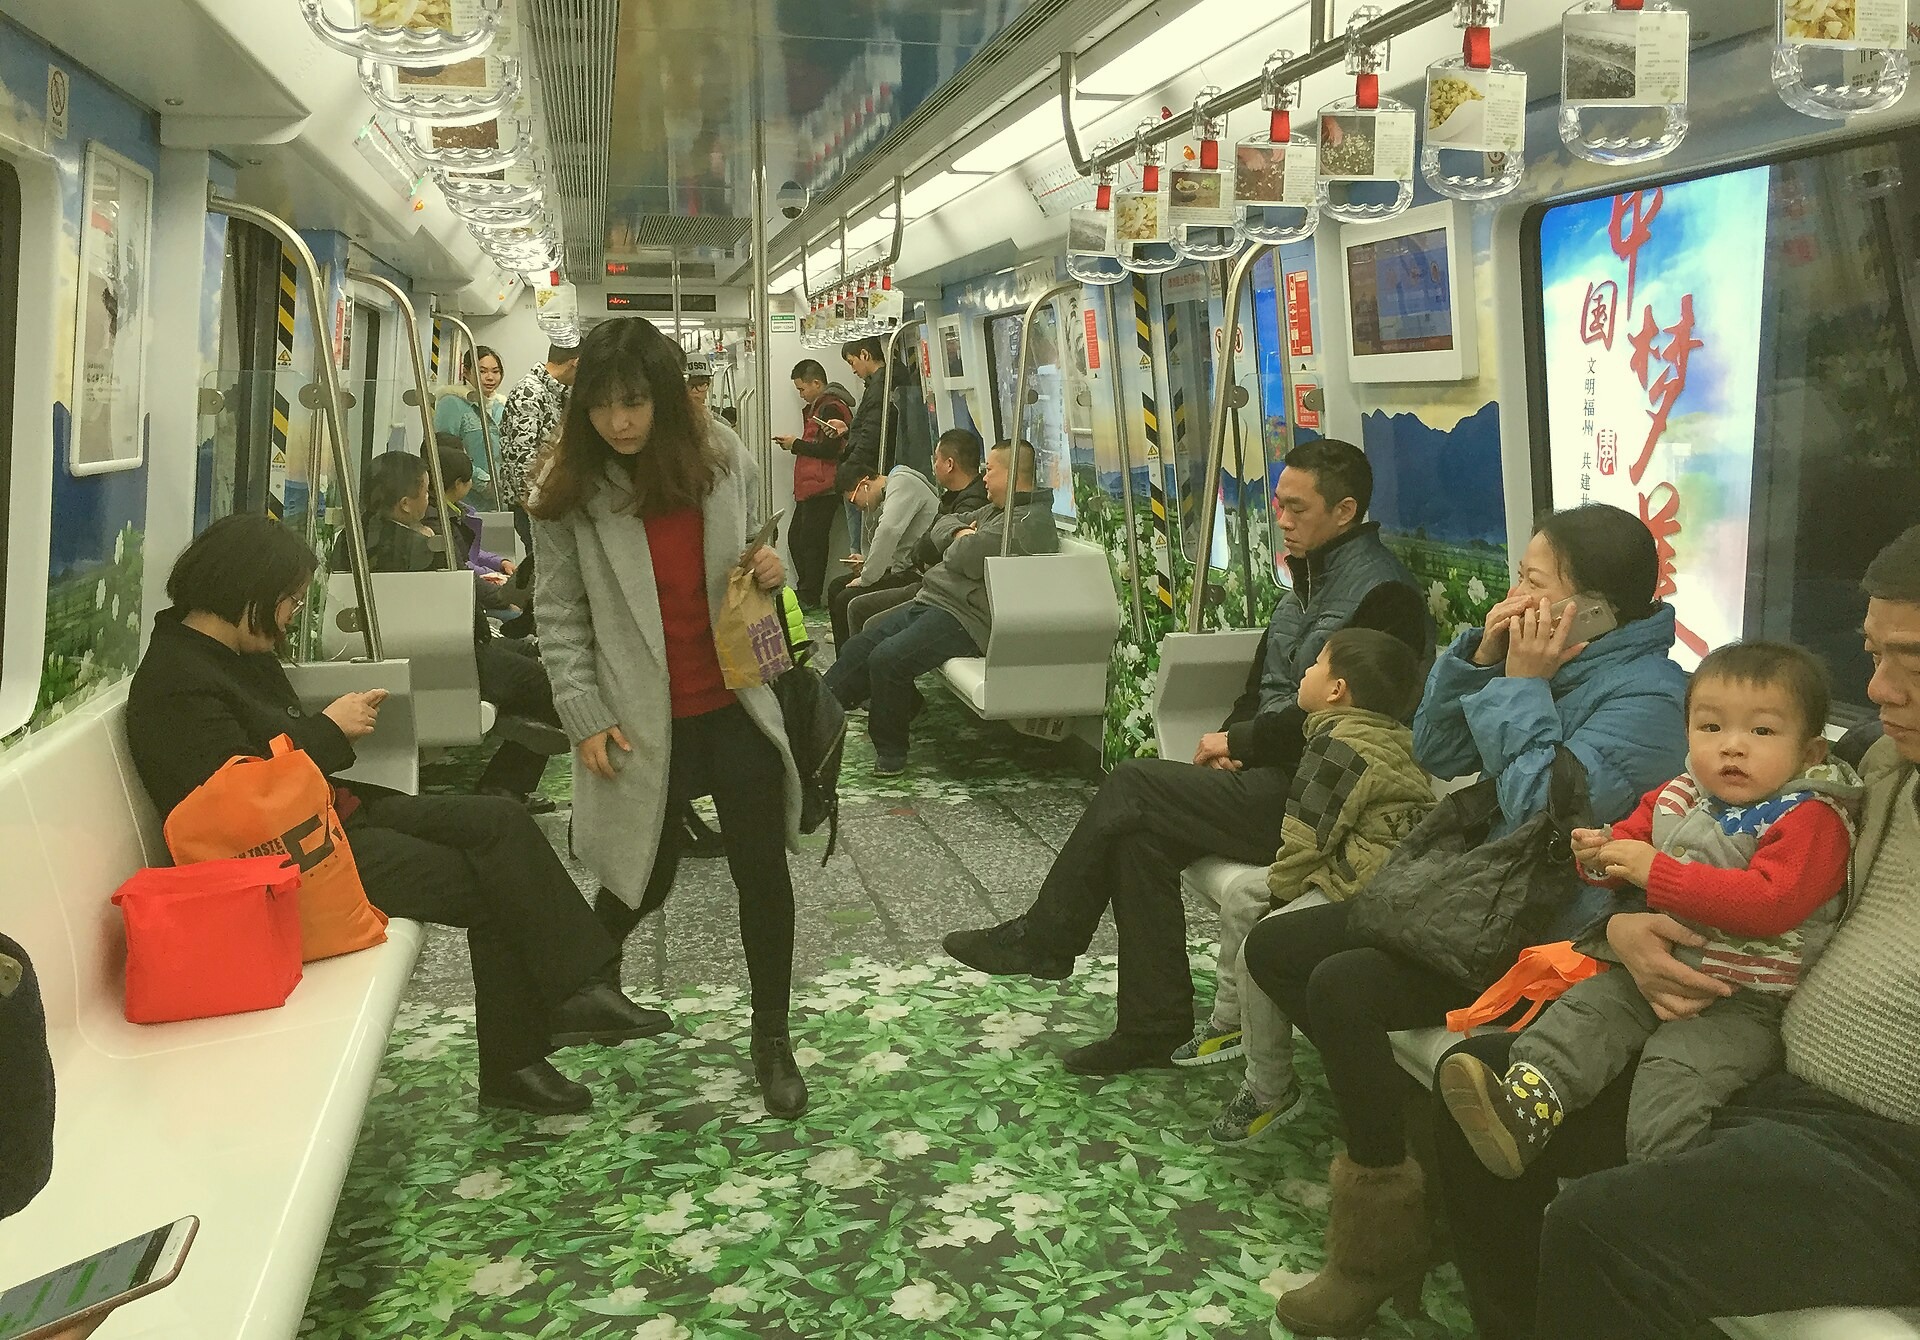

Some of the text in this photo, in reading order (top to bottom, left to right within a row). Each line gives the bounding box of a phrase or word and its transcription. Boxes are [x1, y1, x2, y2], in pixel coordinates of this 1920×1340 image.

[1582, 357, 1597, 437] 文明福州
[247, 838, 282, 857] TASTE
